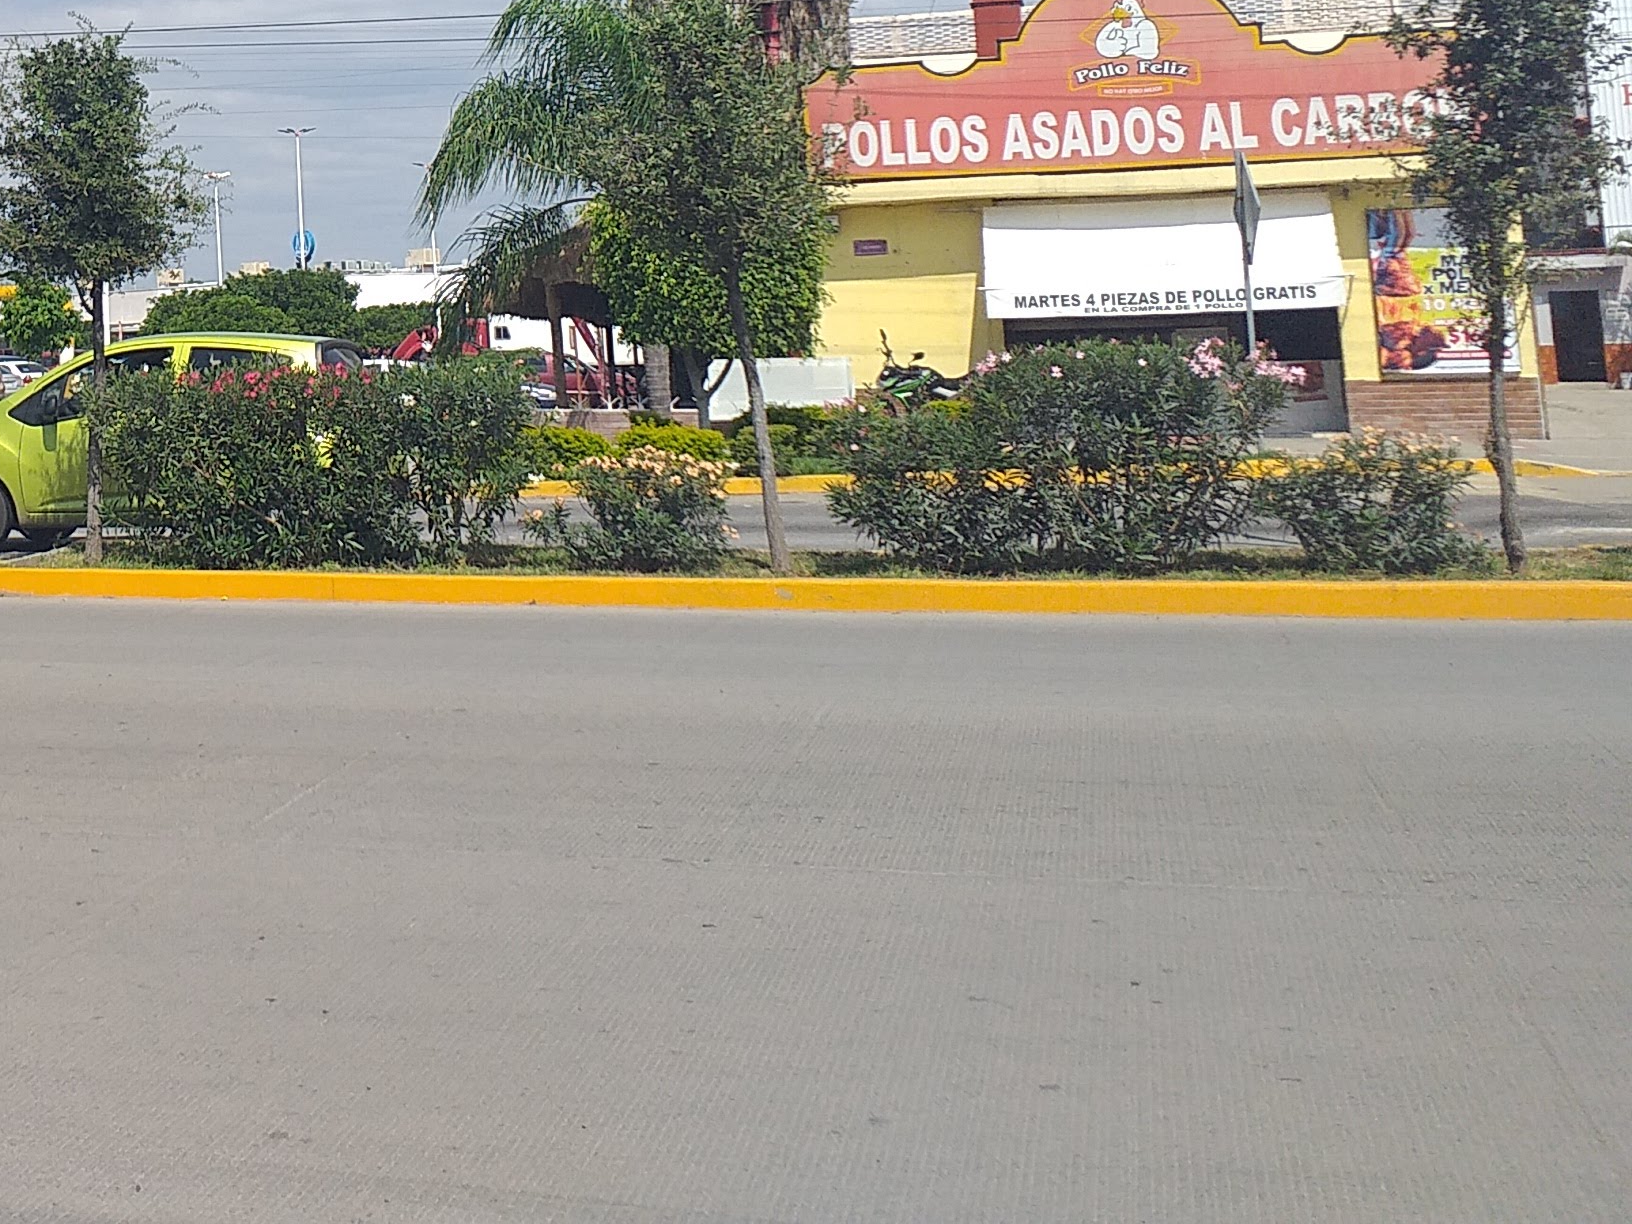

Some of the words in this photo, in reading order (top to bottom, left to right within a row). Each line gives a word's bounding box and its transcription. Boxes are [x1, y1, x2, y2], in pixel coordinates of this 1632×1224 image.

[1074, 62, 1129, 84] Pollo
[1137, 60, 1189, 77] Feliz
[822, 114, 989, 168] POLLOS
[1002, 104, 1185, 162] ASADOS
[1200, 100, 1259, 151] AL
[1014, 294, 1081, 308] MARTES
[1086, 294, 1095, 306] 4
[1101, 291, 1160, 306] PIEZAS
[1165, 290, 1187, 303] DE
[1192, 288, 1247, 303] POLLO
[1253, 285, 1317, 301] GRATIS
[1423, 299, 1445, 310] 10
